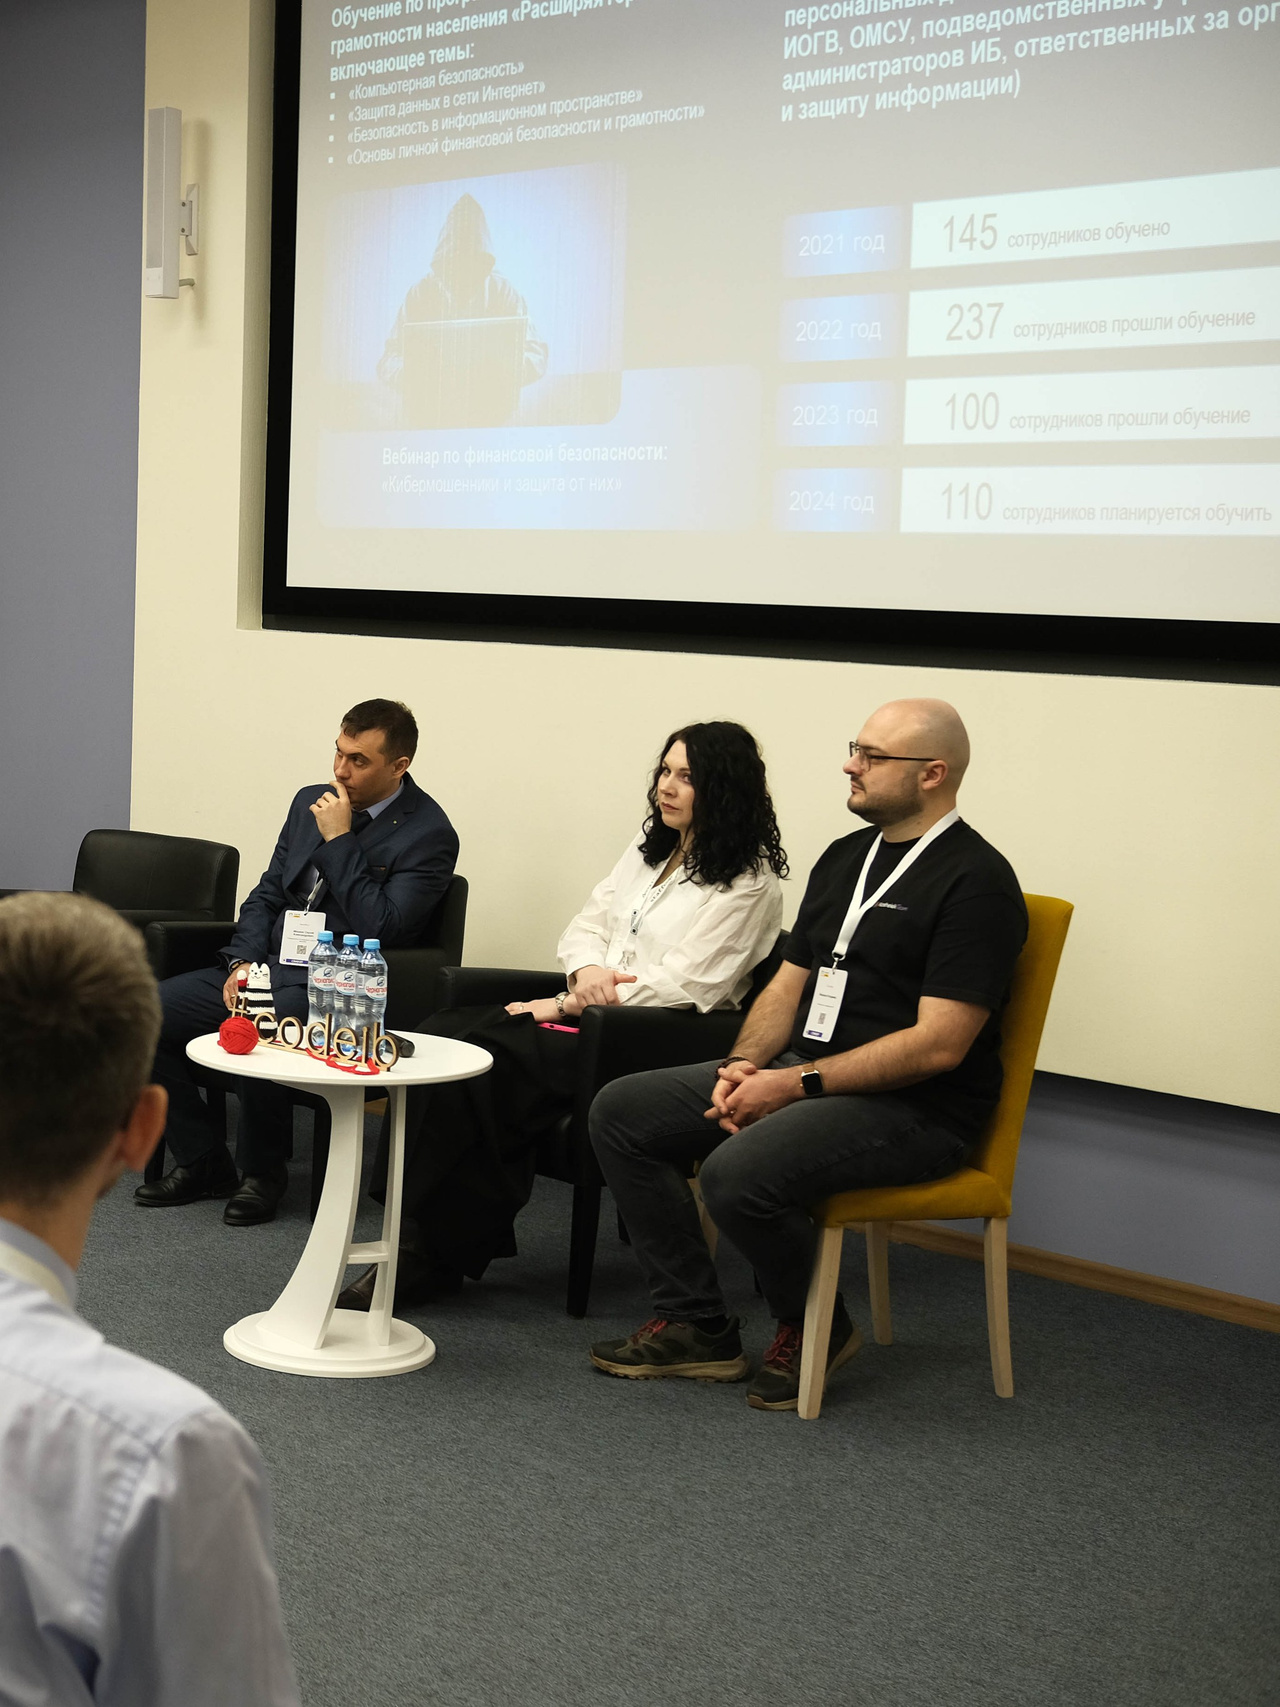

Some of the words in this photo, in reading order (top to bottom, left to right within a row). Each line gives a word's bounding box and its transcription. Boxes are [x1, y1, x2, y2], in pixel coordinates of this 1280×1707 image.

[331, 5, 402, 29] Обучение
[405, 0, 424, 14] по
[331, 25, 422, 59] грамотности
[426, 9, 508, 38] населения
[782, 49, 964, 93] администраторов
[970, 37, 1008, 65] ИБ,
[1014, 15, 1196, 58] ответственных
[1202, 10, 1230, 31] за
[783, 29, 843, 59] ИОГВ,
[849, 18, 916, 45] ОМСУ,
[330, 52, 426, 82] включающее
[428, 43, 475, 65] темы:
[348, 76, 436, 100] «Компьютерная
[438, 61, 525, 87] безопасность»
[348, 102, 396, 122] «Защита
[397, 96, 441, 118] данных
[443, 96, 450, 109] в
[452, 91, 479, 107] сети
[482, 81, 546, 103] Интернет»
[780, 104, 793, 122] и
[797, 94, 870, 119] защиту
[874, 69, 1021, 112] информации)
[346, 148, 396, 165] «Основы
[398, 140, 439, 159] личной
[441, 126, 513, 155] финансовой
[516, 120, 601, 143] безопасности
[604, 117, 612, 131] и
[615, 105, 705, 132] грамотности»
[347, 120, 430, 143] «Безопасность
[432, 119, 439, 132] в
[441, 103, 547, 131] информационном
[549, 89, 643, 118] пространстве»
[798, 234, 844, 257] 2021
[852, 233, 886, 254] год
[942, 212, 999, 253] 145
[1007, 226, 1102, 250] сотрудников
[1105, 220, 1171, 243] обучено
[795, 319, 843, 342] 2022
[850, 320, 882, 341] год
[945, 302, 1005, 342] 237
[1013, 318, 1108, 341] сотрудников
[1111, 314, 1173, 337] прошли
[1177, 310, 1256, 333] обучение
[791, 404, 840, 426] 2023
[846, 407, 879, 428] год
[944, 391, 1000, 431] 100
[1009, 413, 1103, 434] сотрудников
[1106, 410, 1169, 431] прошли
[1173, 407, 1251, 430] обучение
[382, 447, 440, 469] Вебинар
[443, 450, 460, 465] по
[464, 445, 553, 468] финансовой
[558, 443, 668, 463] безопасности:
[382, 474, 499, 496] «Кибермошенники
[515, 476, 566, 495] защита
[569, 477, 585, 492] от
[589, 476, 623, 492] них»
[787, 490, 837, 512] 2024
[843, 495, 875, 514] год
[941, 482, 994, 521] 110
[1002, 506, 1096, 526] сотрудников
[1099, 505, 1201, 526] планируется
[1205, 503, 1273, 526] обучить
